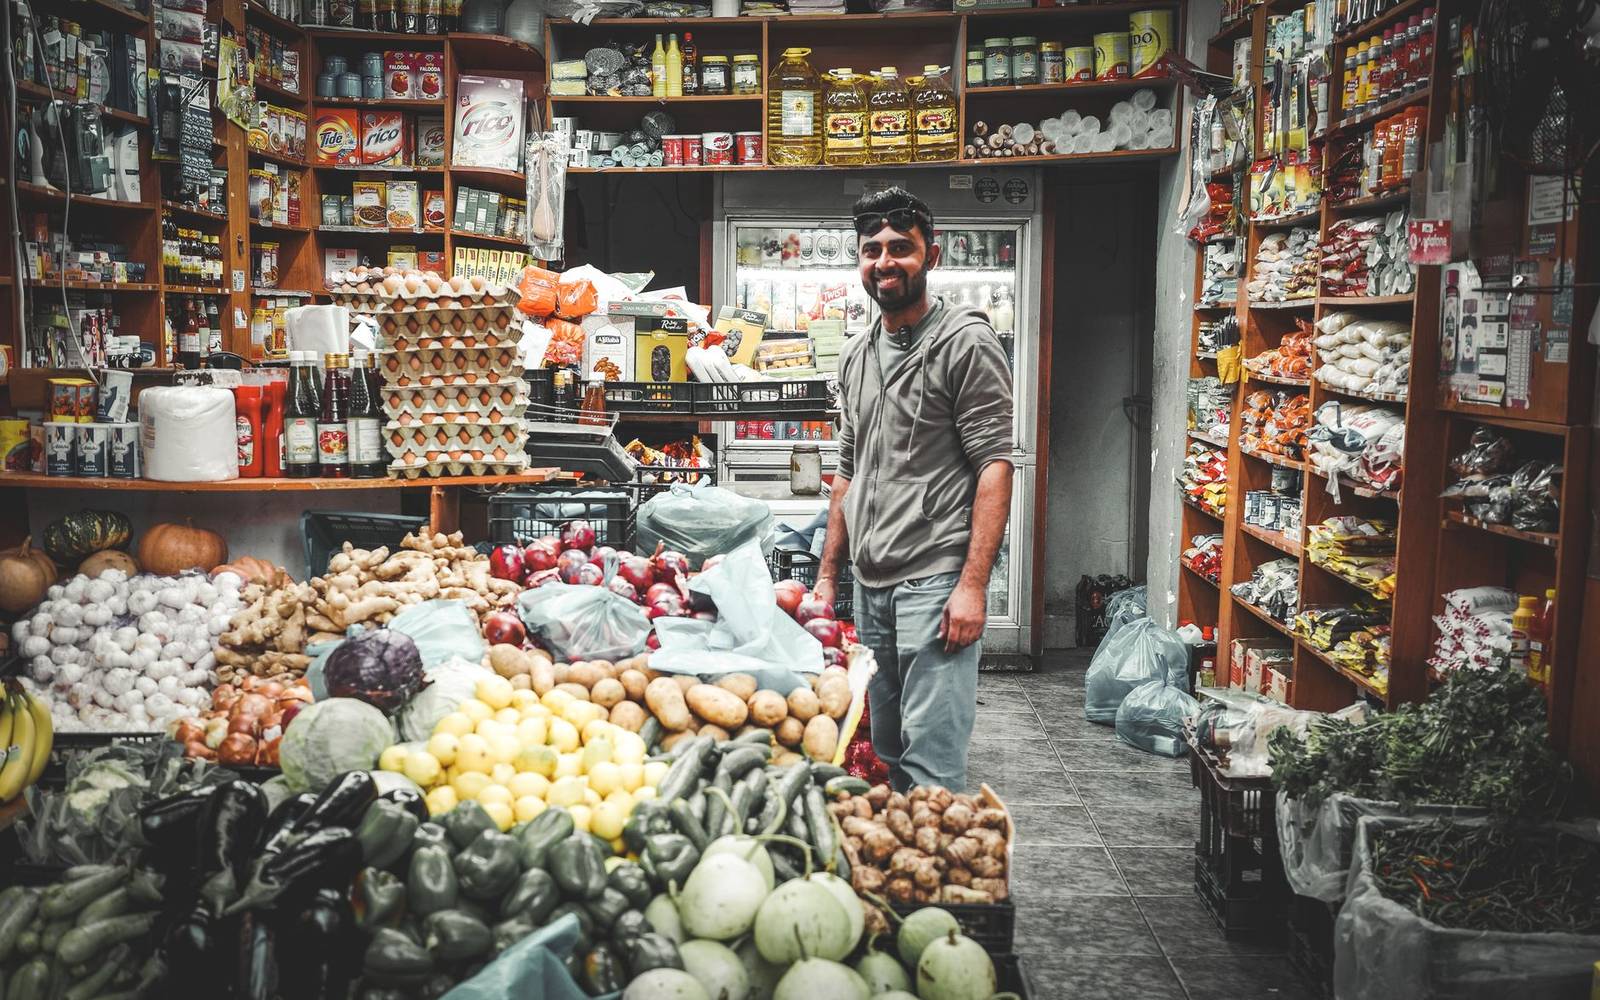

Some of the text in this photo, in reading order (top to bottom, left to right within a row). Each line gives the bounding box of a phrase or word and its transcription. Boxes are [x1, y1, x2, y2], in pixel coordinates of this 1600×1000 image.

[463, 113, 511, 136] rico
[319, 132, 343, 148] Tide
[366, 128, 399, 146] rico
[822, 287, 848, 301] TWIST
